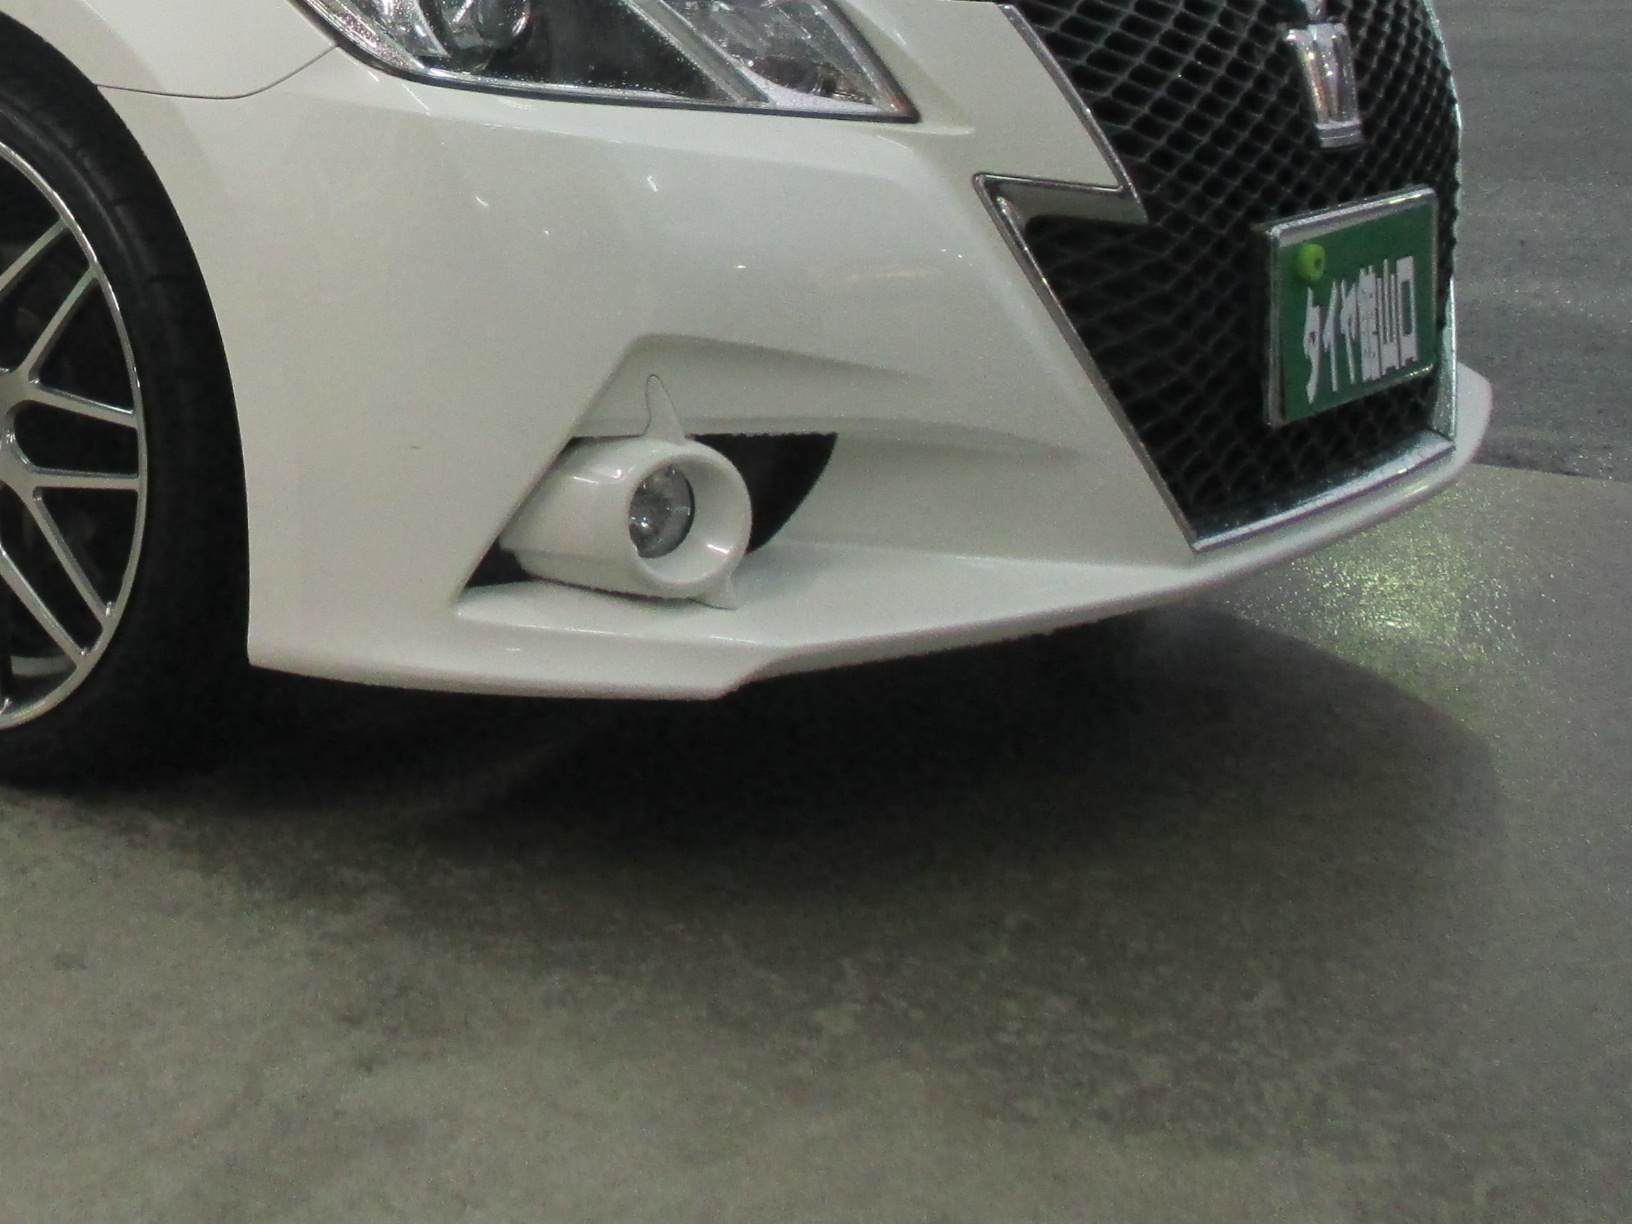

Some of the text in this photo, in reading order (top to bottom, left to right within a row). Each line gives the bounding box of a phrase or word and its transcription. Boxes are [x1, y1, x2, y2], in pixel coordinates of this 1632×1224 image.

[1302, 255, 1417, 404] タイヤ館山口
